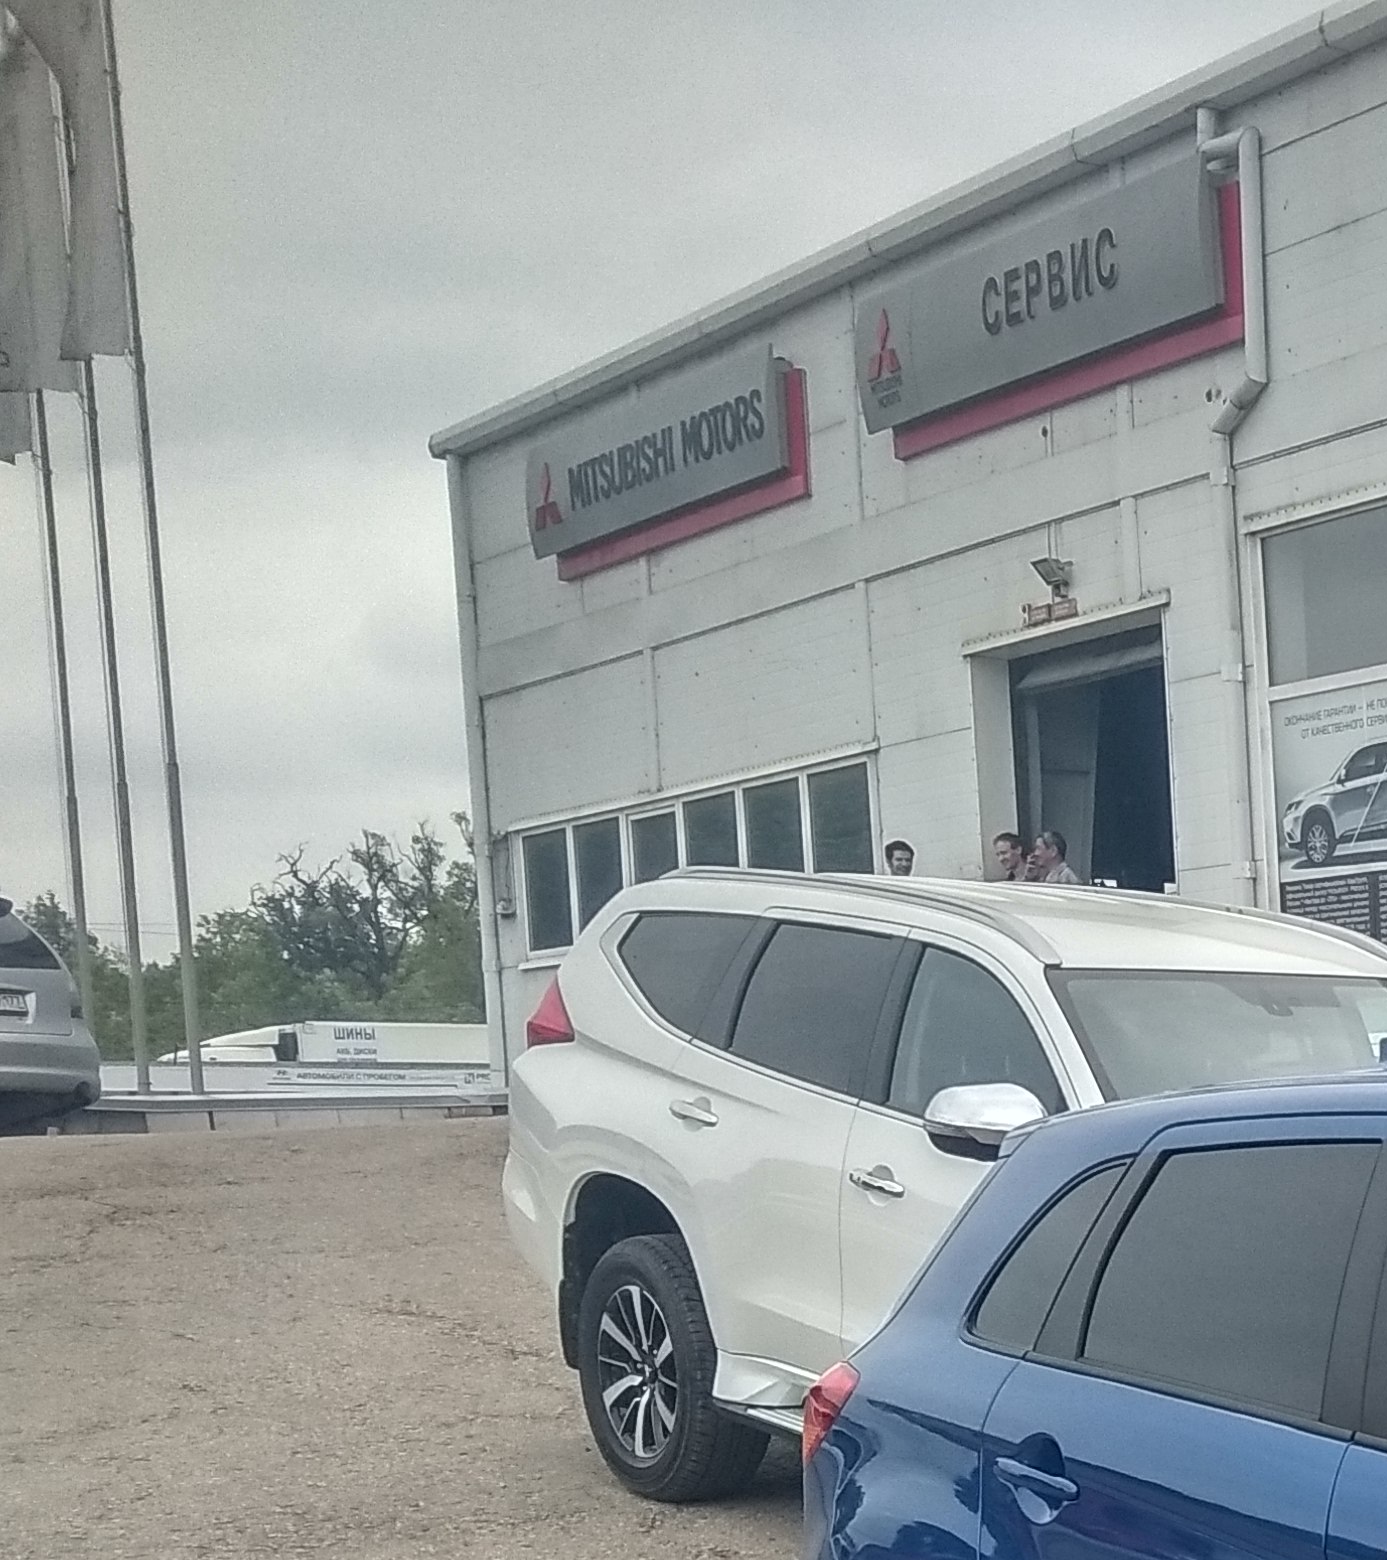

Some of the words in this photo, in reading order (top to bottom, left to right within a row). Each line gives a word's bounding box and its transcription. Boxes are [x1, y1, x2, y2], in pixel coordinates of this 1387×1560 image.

[981, 227, 1119, 336] СЕРВИС
[567, 425, 676, 512] MITSUBISHI
[679, 388, 765, 468] MOTORS
[1283, 709, 1323, 728] ОКОНЧАНИЕ
[1323, 705, 1357, 720] ГАРАНТИИ
[1365, 701, 1376, 712] НЕ
[1301, 728, 1312, 740] ОТ
[1311, 717, 1365, 738] КАЧЕСТВЕННОГО
[334, 1026, 376, 1040] ШИНЫ
